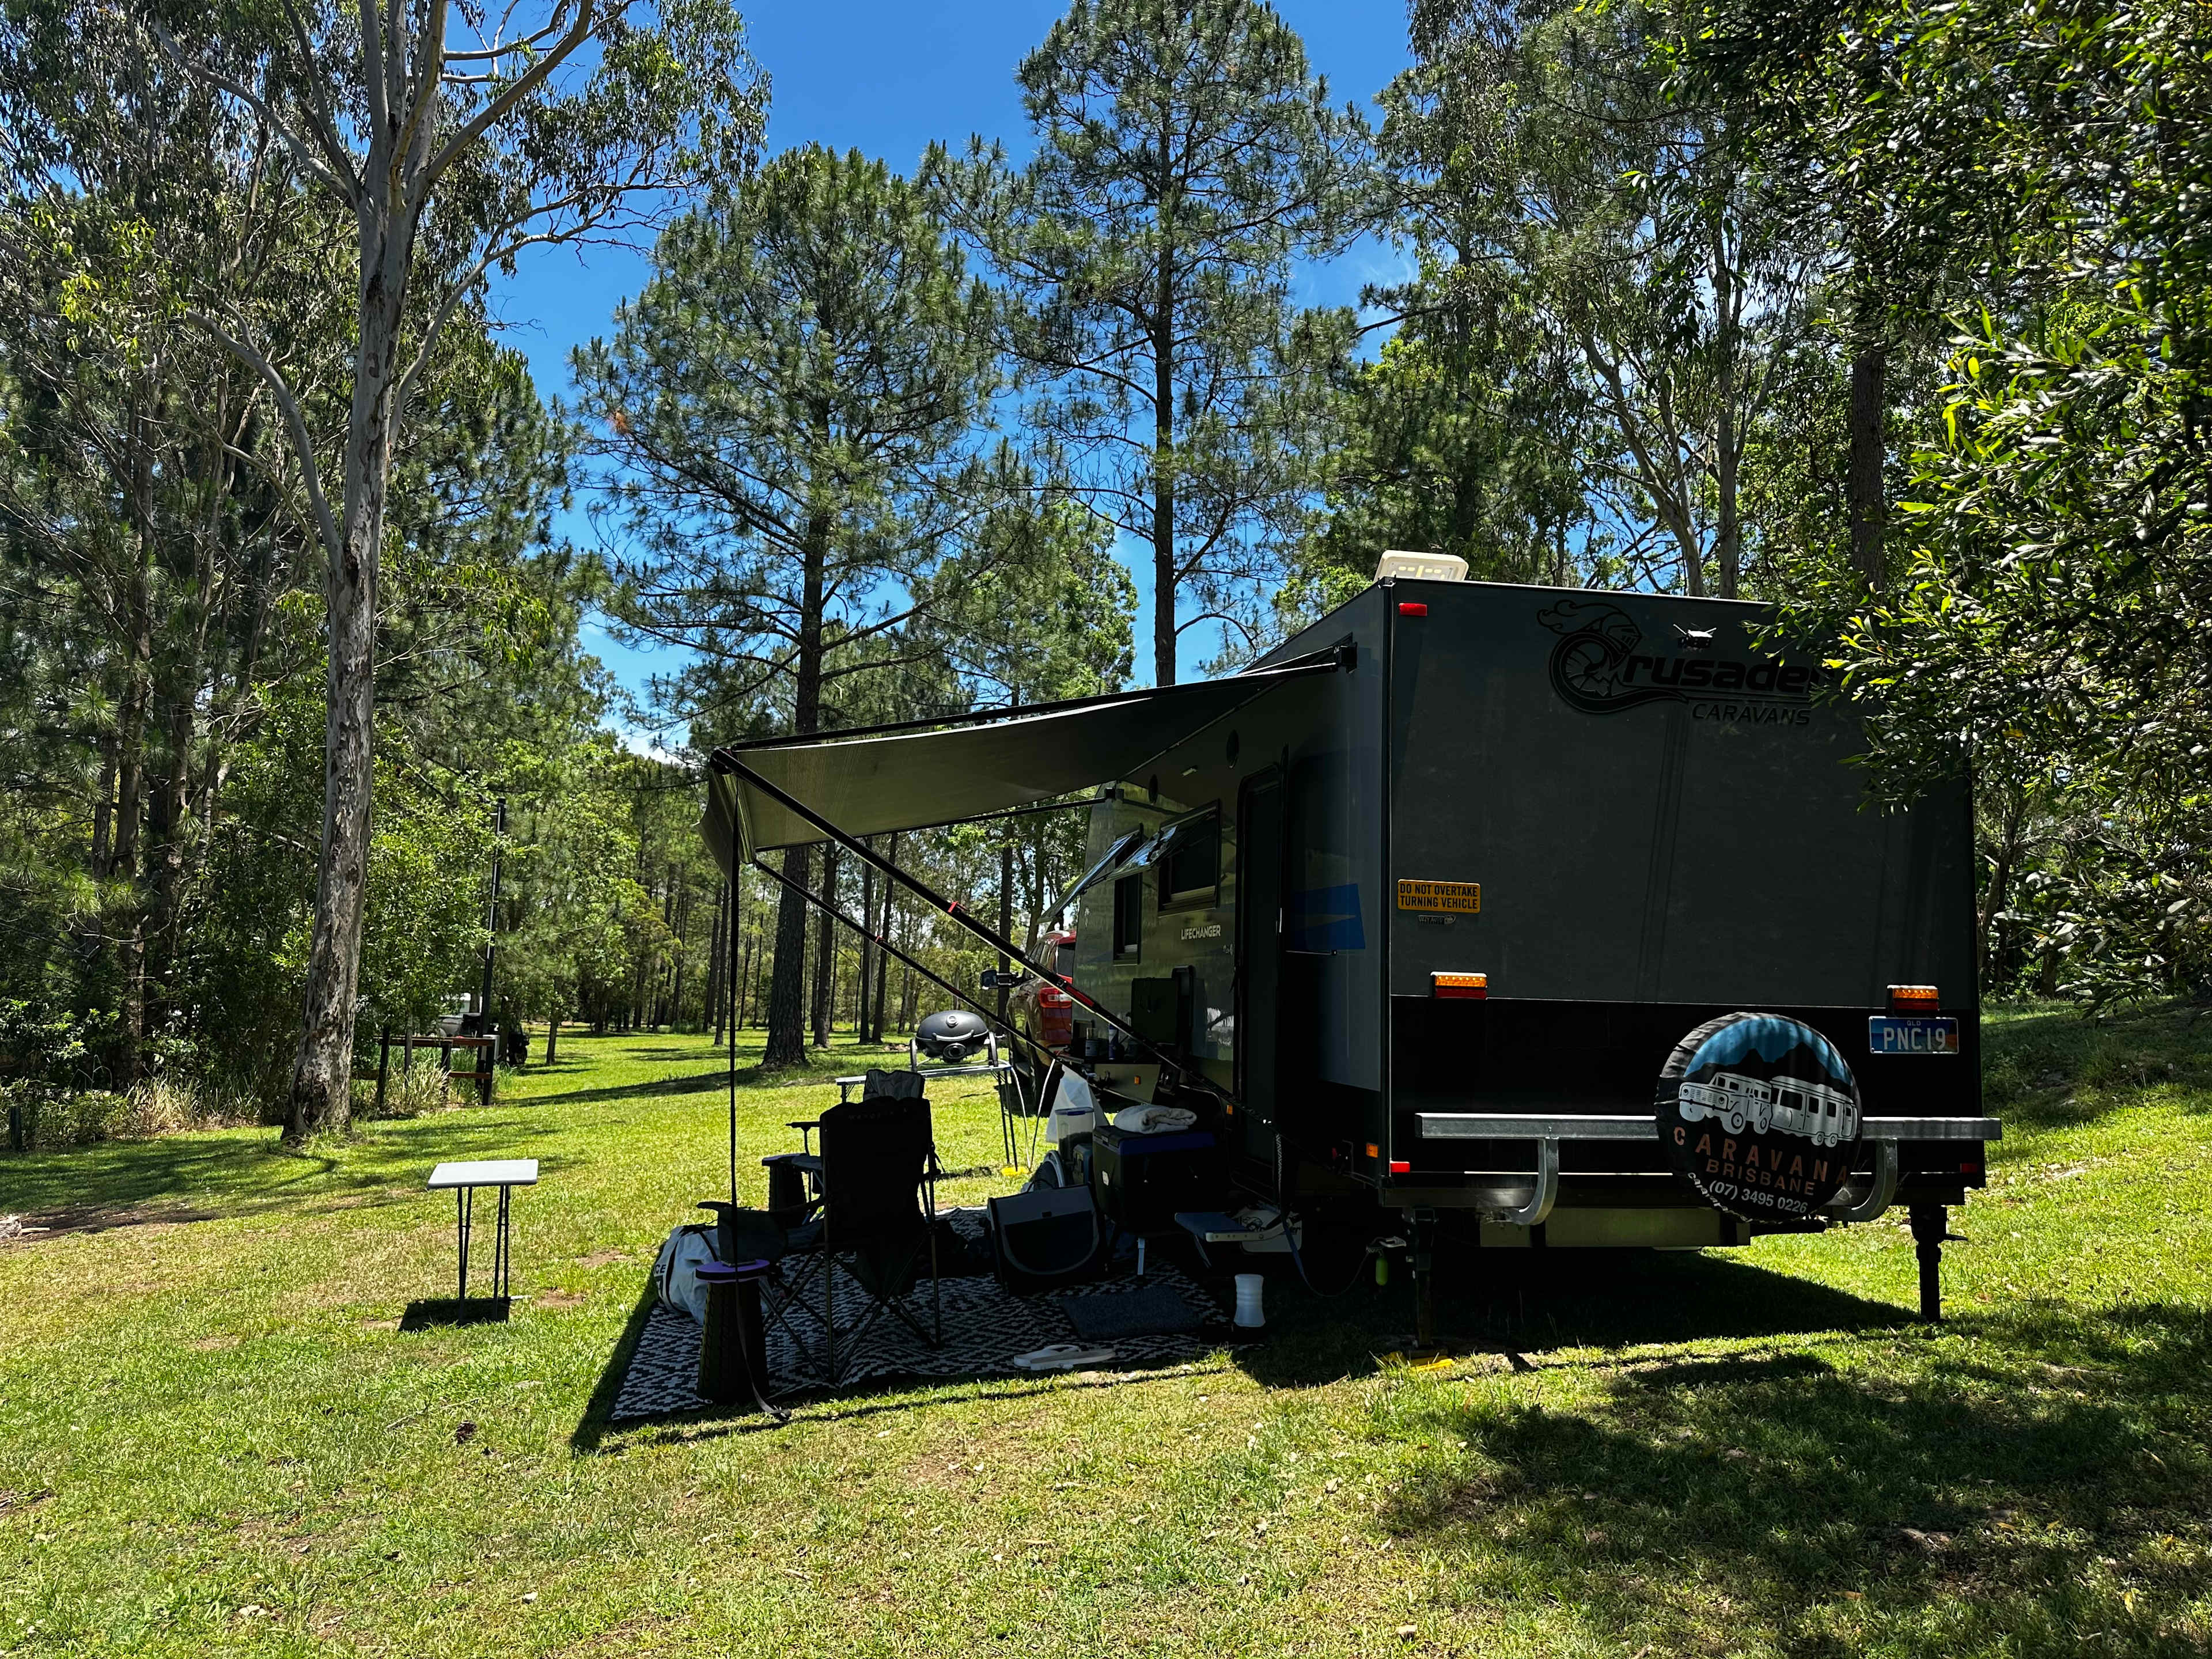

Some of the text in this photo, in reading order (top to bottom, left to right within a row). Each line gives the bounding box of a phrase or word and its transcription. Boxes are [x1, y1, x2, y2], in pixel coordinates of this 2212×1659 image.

[1692, 703, 1811, 725] CARAVANS
[1400, 883, 1478, 897] DO NOT OVERTAKE
[1400, 896, 1478, 909] TURNING VEHICLE
[1181, 925, 1221, 940] LIFECHANGER
[1884, 1027, 1946, 1050] PNC19
[1673, 1126, 1849, 1185] CARAVANA
[1706, 1159, 1815, 1196] BRISBANE
[1709, 1180, 1808, 1213] (07) 3495 0226
